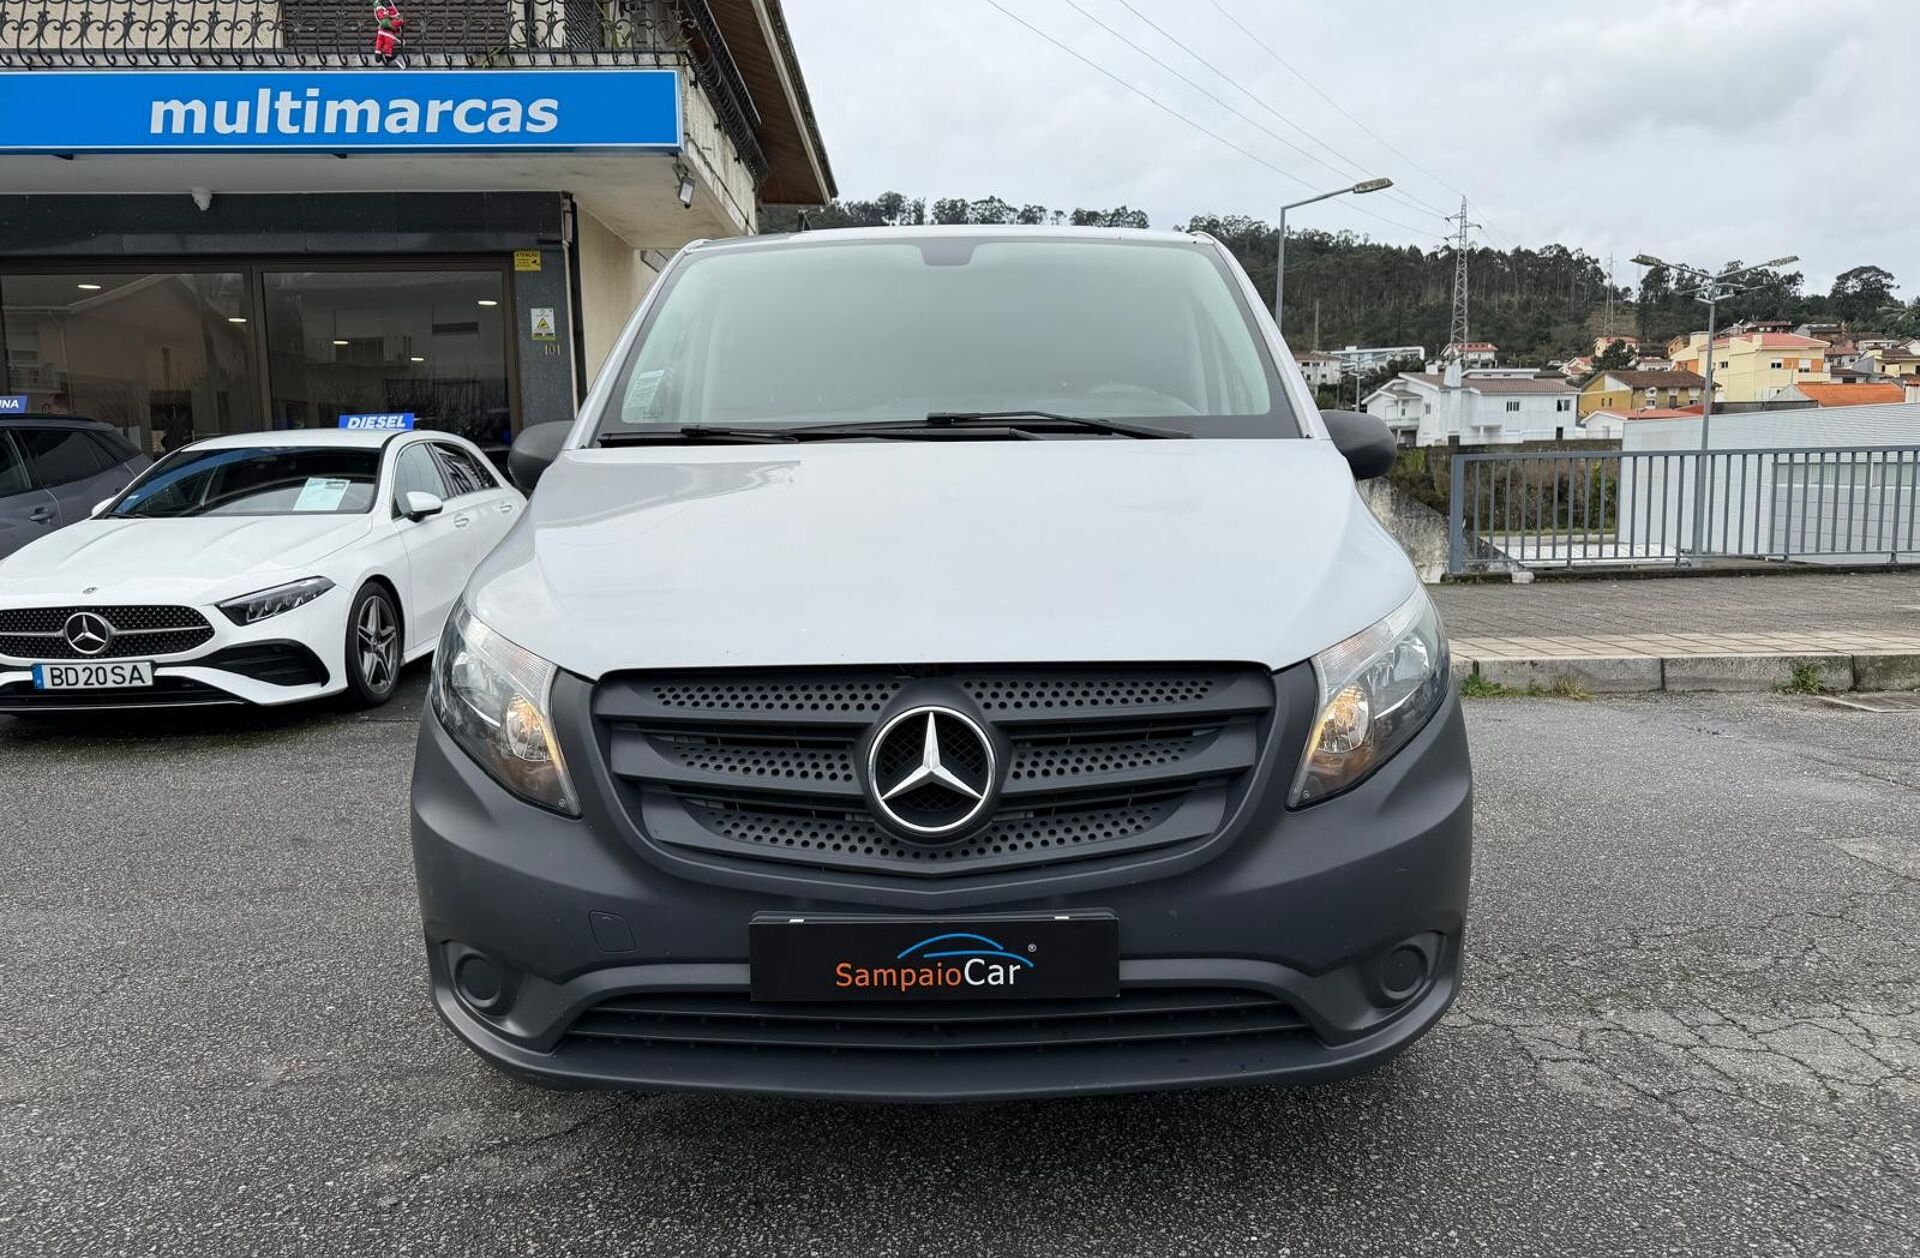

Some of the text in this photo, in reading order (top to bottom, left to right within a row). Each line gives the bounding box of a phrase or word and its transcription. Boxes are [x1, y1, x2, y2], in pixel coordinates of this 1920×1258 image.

[150, 88, 559, 134] multimarcas
[347, 415, 406, 429] DIESEL
[835, 958, 1021, 991] SampaioCar
